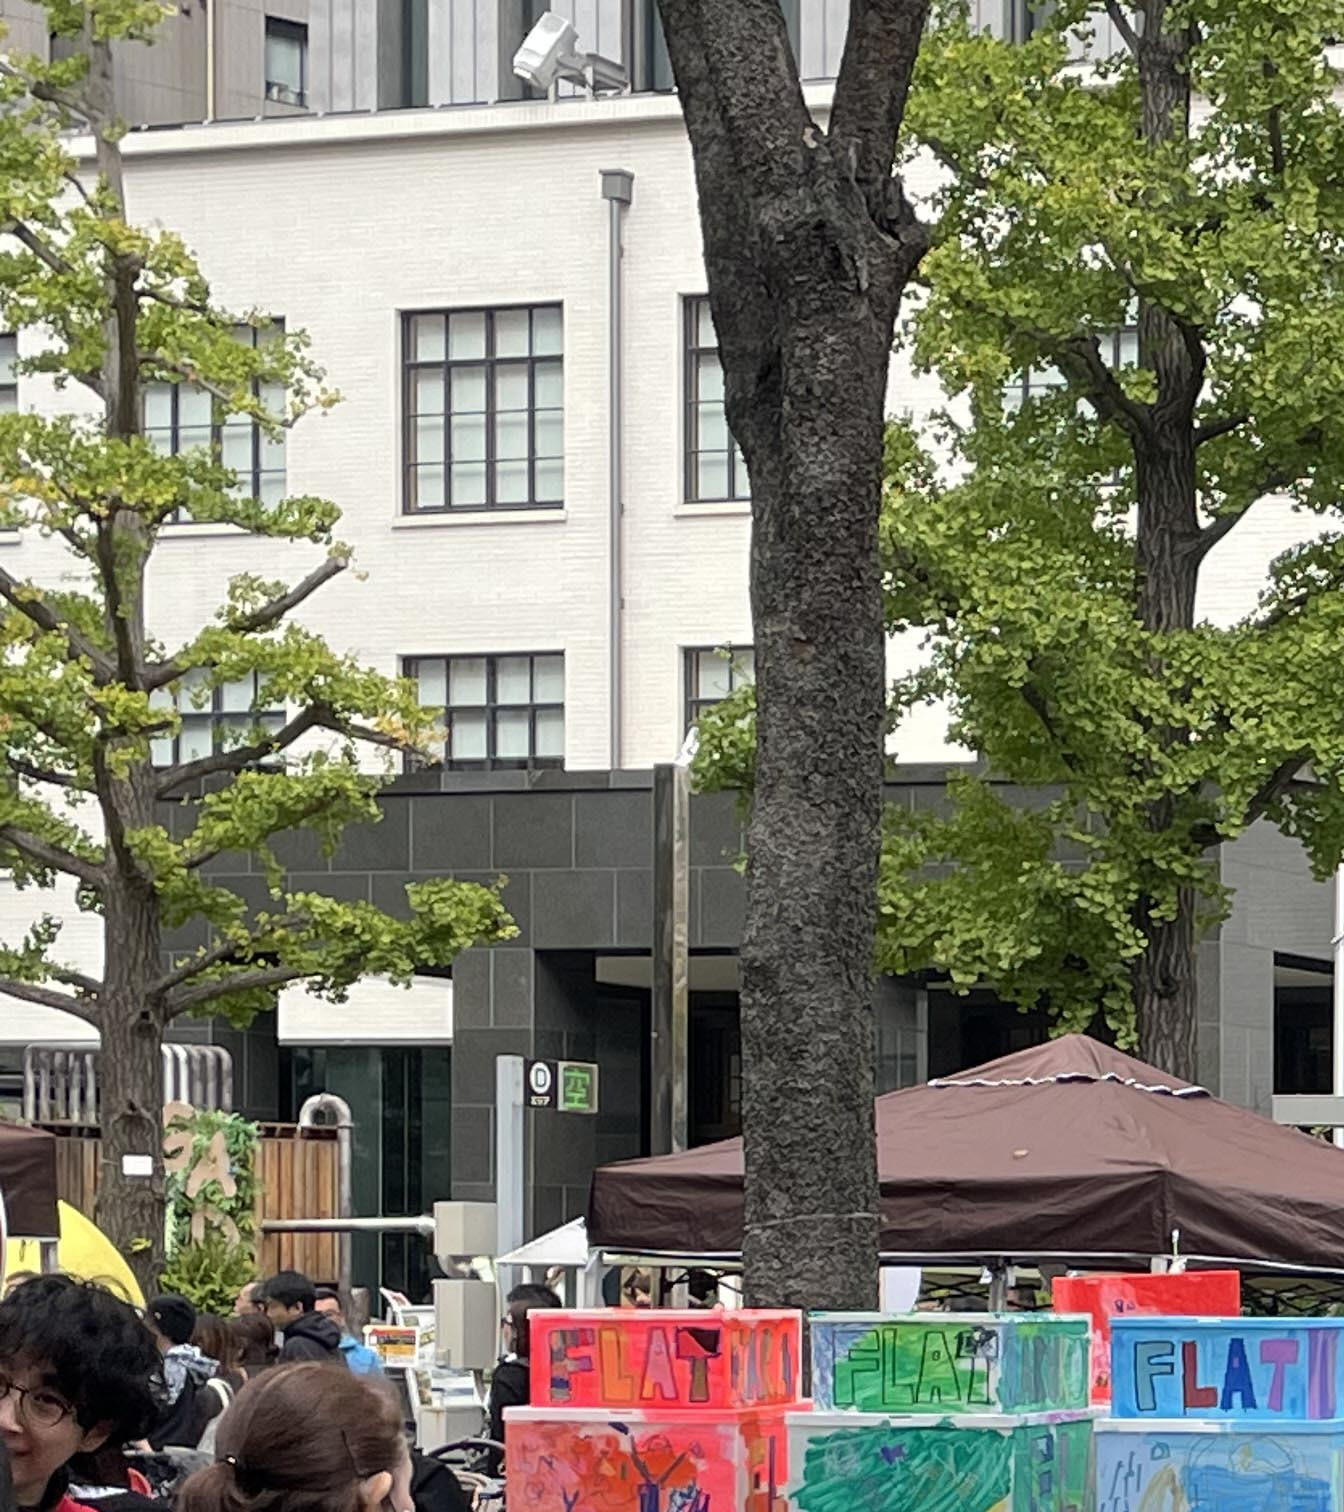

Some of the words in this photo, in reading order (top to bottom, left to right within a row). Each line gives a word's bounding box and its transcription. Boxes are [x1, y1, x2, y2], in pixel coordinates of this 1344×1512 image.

[563, 1067, 591, 1109] 空
[548, 1326, 722, 1403] FLAT
[832, 1325, 1000, 1406] FLAT
[1132, 1337, 1299, 1412] FLAT
